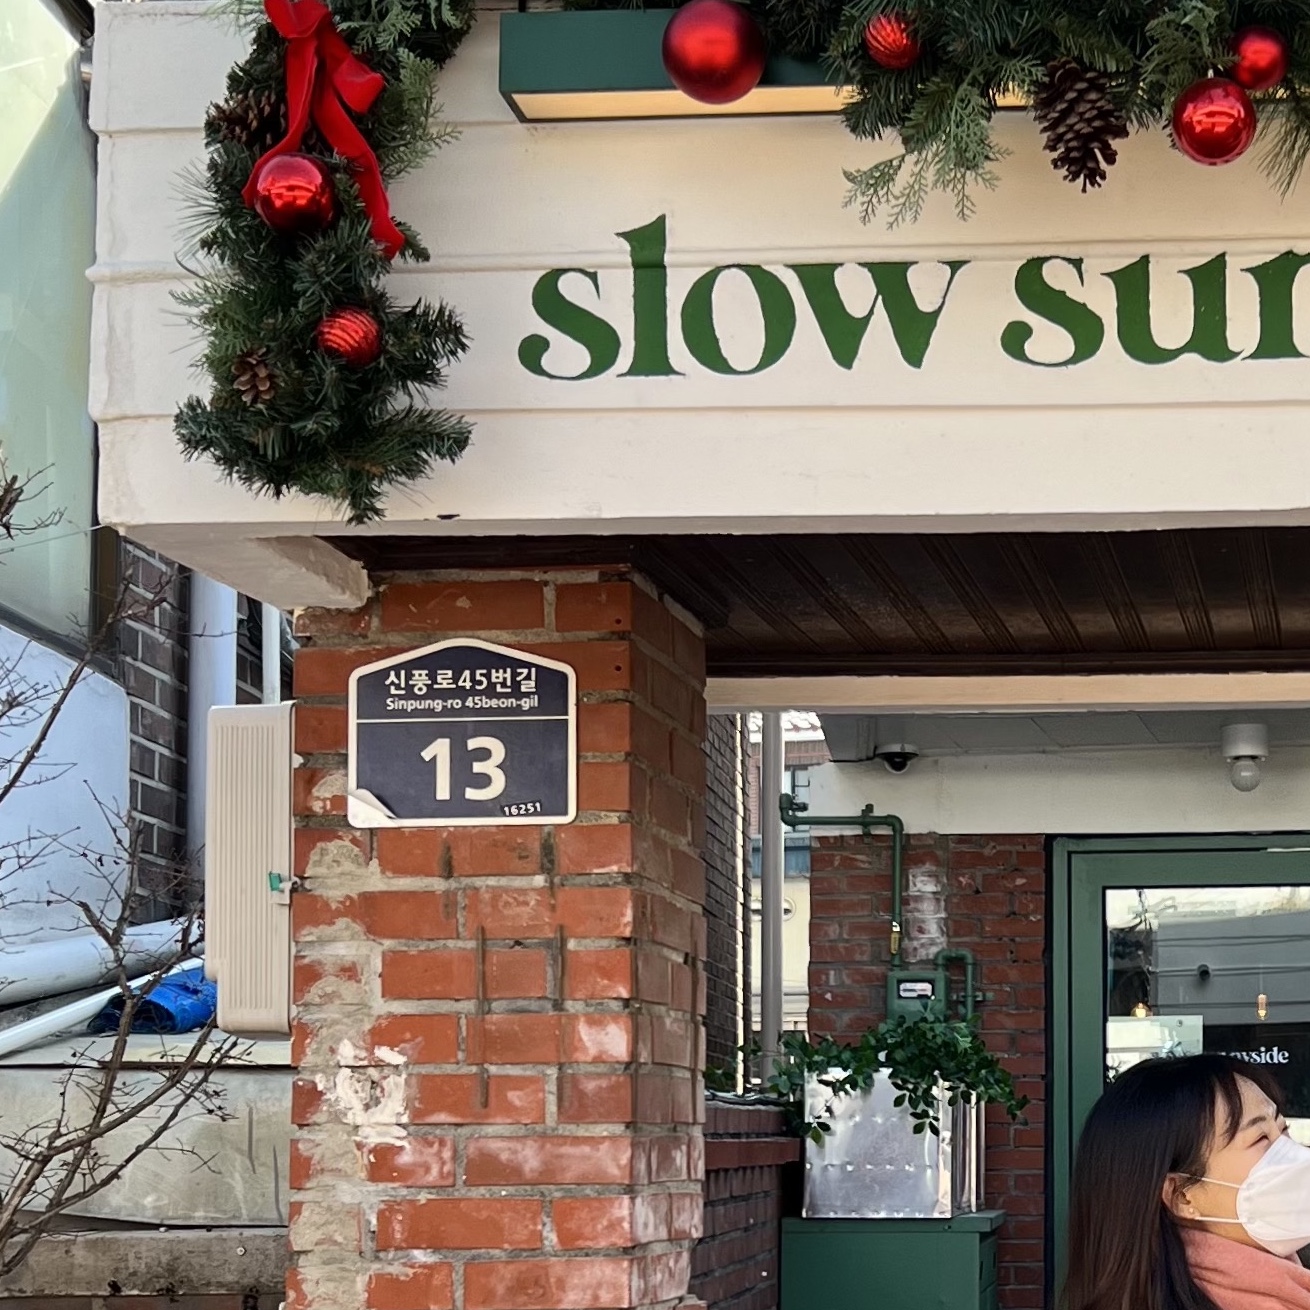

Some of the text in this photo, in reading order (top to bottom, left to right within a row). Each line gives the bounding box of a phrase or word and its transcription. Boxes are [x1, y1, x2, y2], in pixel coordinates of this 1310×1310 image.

[518, 213, 972, 380] slow
[384, 667, 537, 695] 신풍로45번길
[386, 695, 539, 711] Sinpung-ro 45beon-gil
[420, 736, 506, 801] 13
[503, 802, 541, 816] 16251
